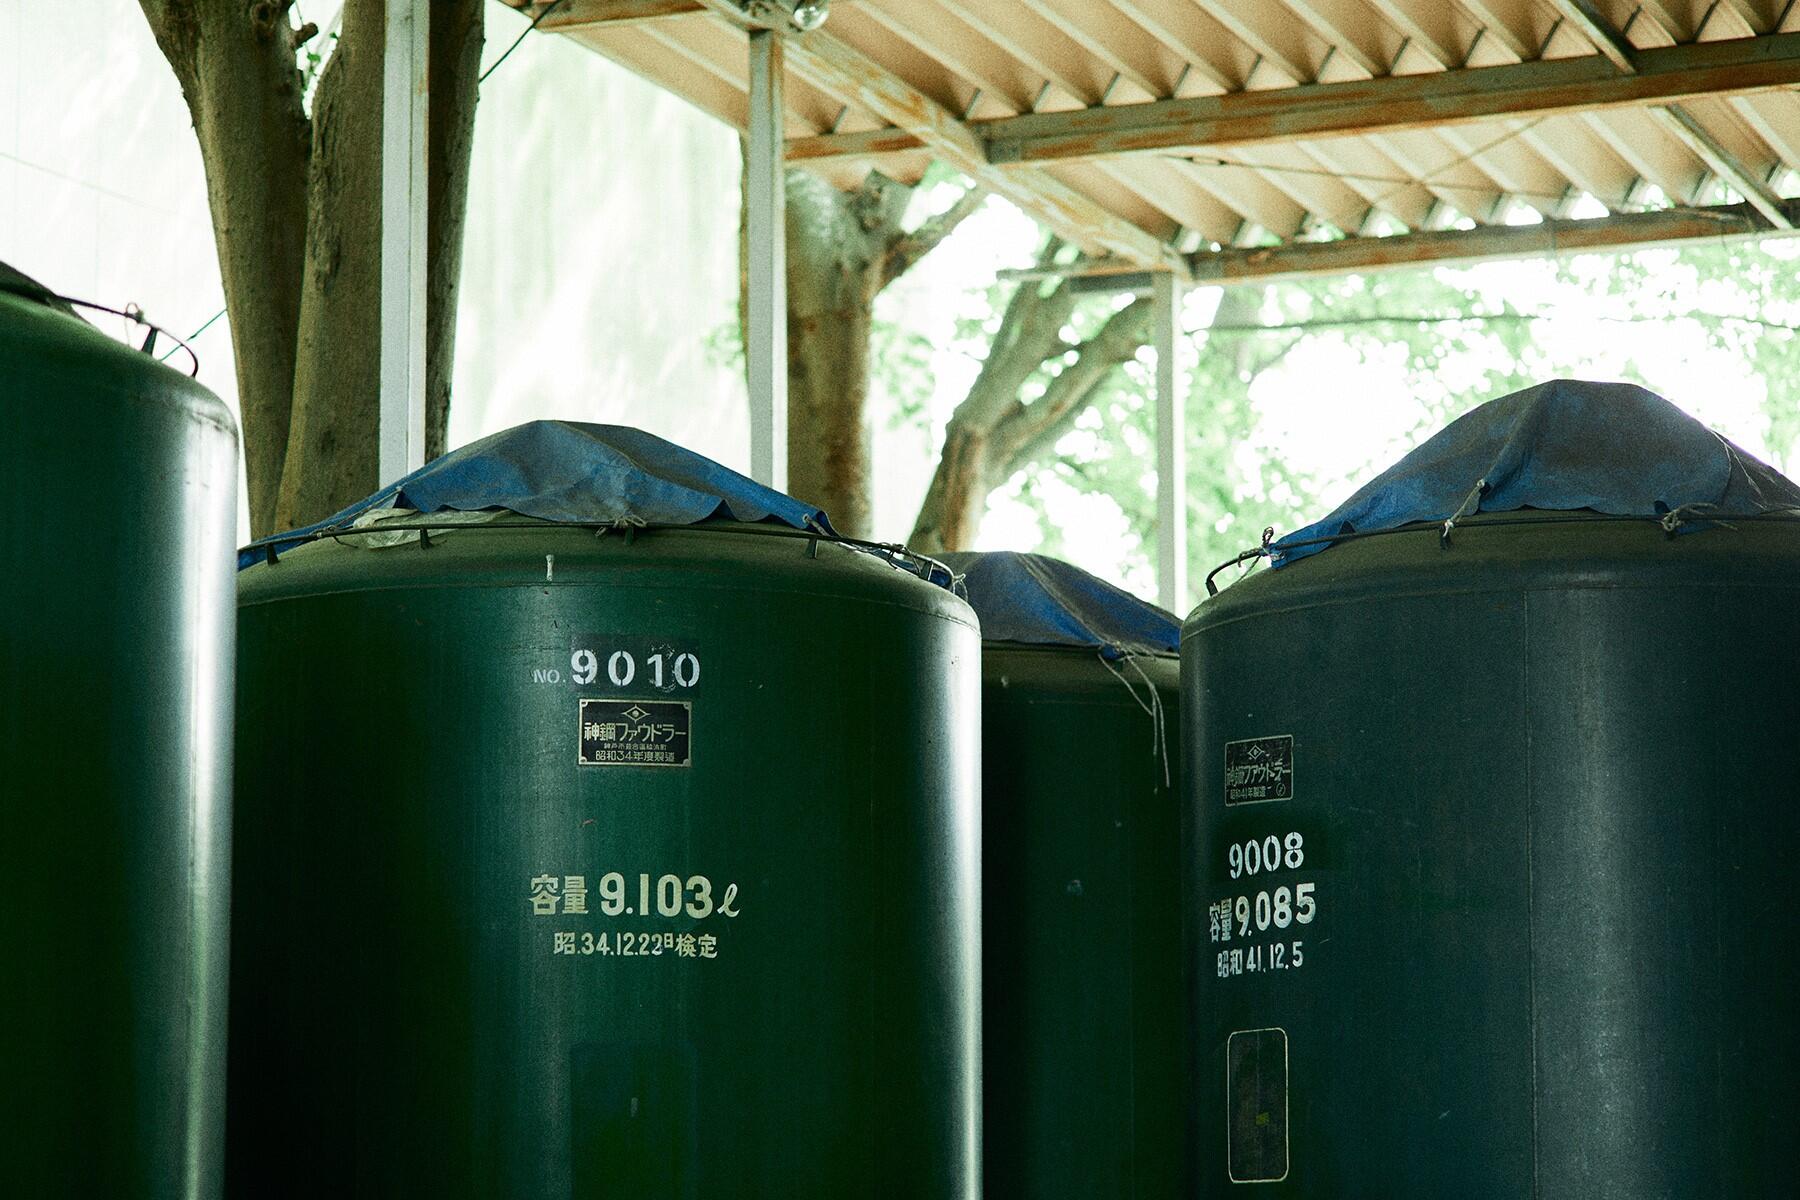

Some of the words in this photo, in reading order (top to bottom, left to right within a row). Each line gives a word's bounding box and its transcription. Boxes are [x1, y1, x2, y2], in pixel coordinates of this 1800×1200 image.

[570, 649, 700, 688] 9010
[1229, 832, 1304, 879] 9008
[529, 873, 589, 916] 容量
